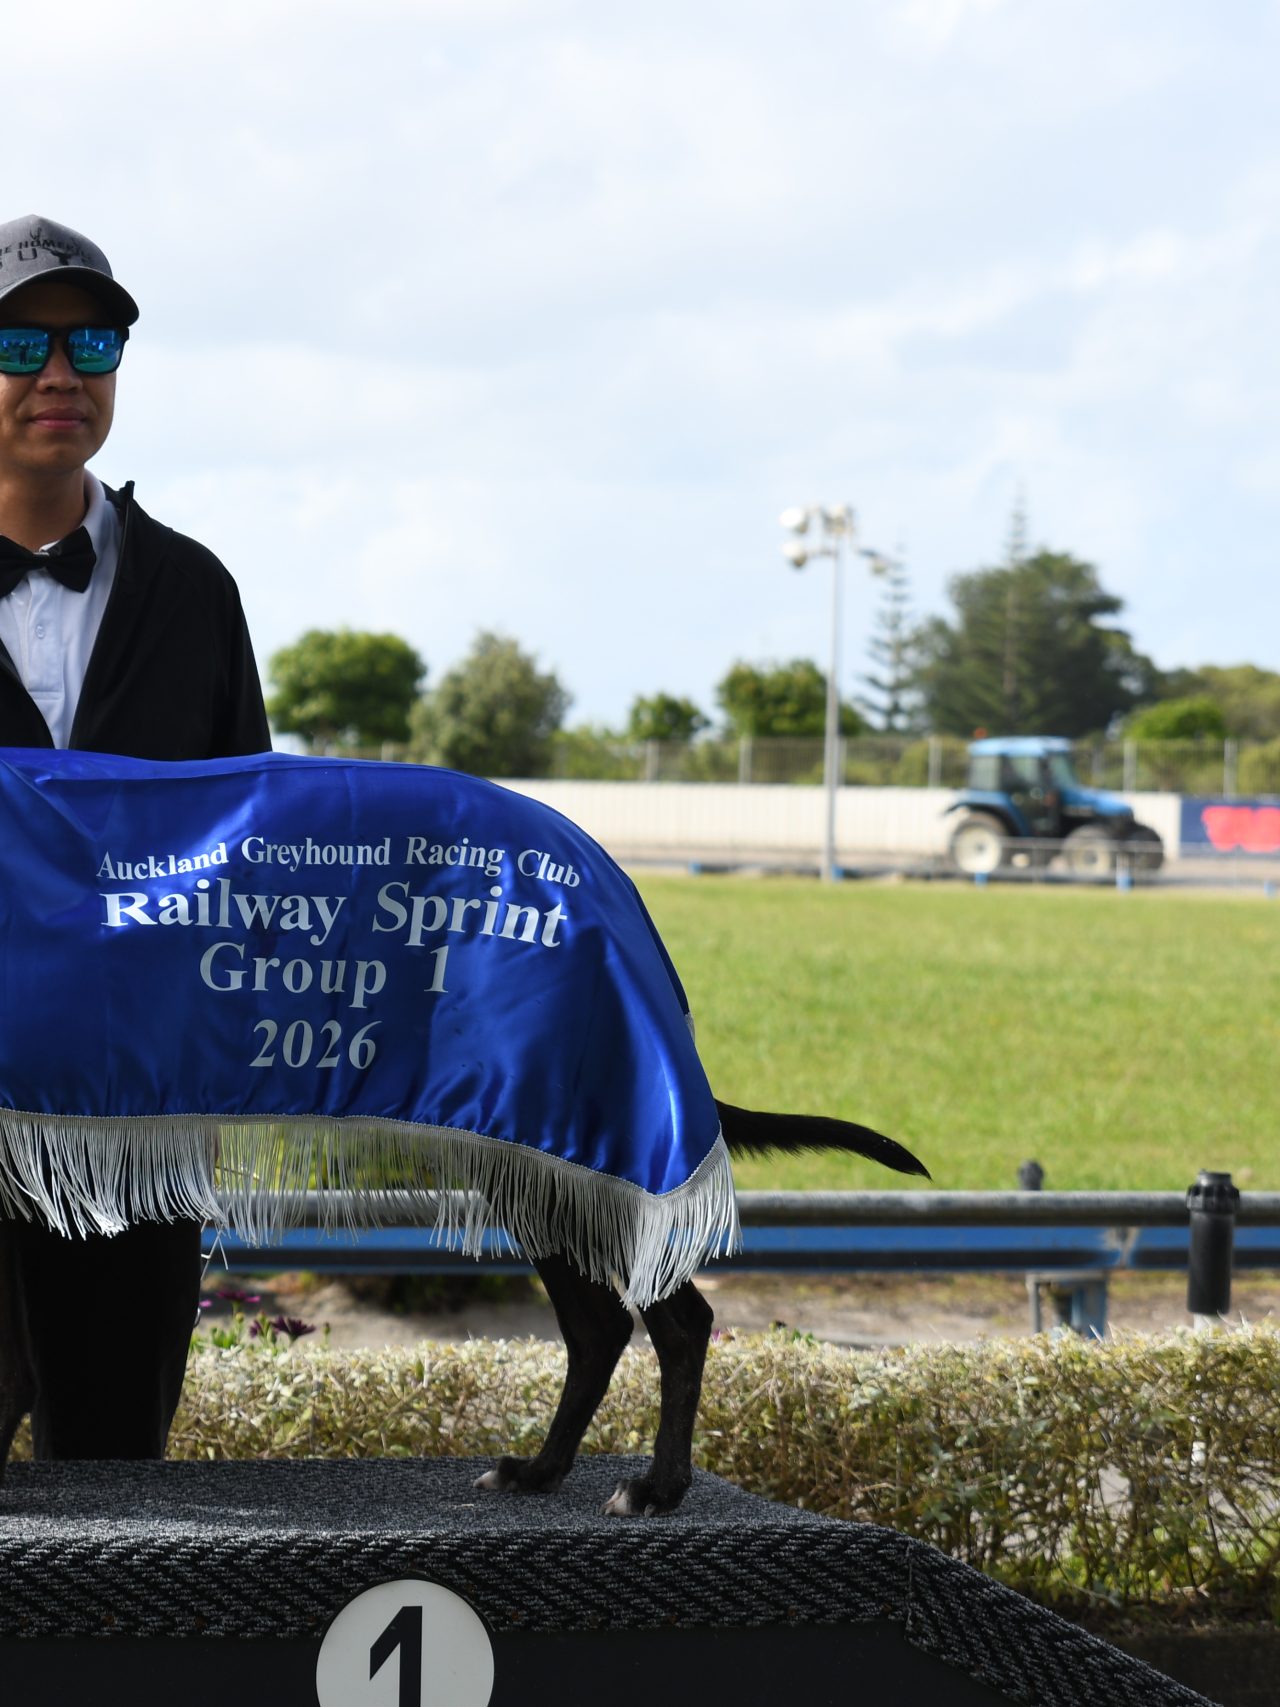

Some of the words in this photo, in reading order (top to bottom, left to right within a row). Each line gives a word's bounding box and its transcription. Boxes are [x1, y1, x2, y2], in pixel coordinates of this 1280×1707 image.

[96, 842, 229, 881] Auckland
[241, 836, 391, 872] Greyhound
[405, 836, 506, 876] Racing
[517, 848, 580, 888] Club
[99, 877, 347, 946] Railway
[372, 881, 568, 948] Sprint
[199, 942, 388, 1008] Group
[423, 945, 450, 993] 1
[248, 1019, 383, 1070] 2026
[369, 1605, 423, 1707] 1
